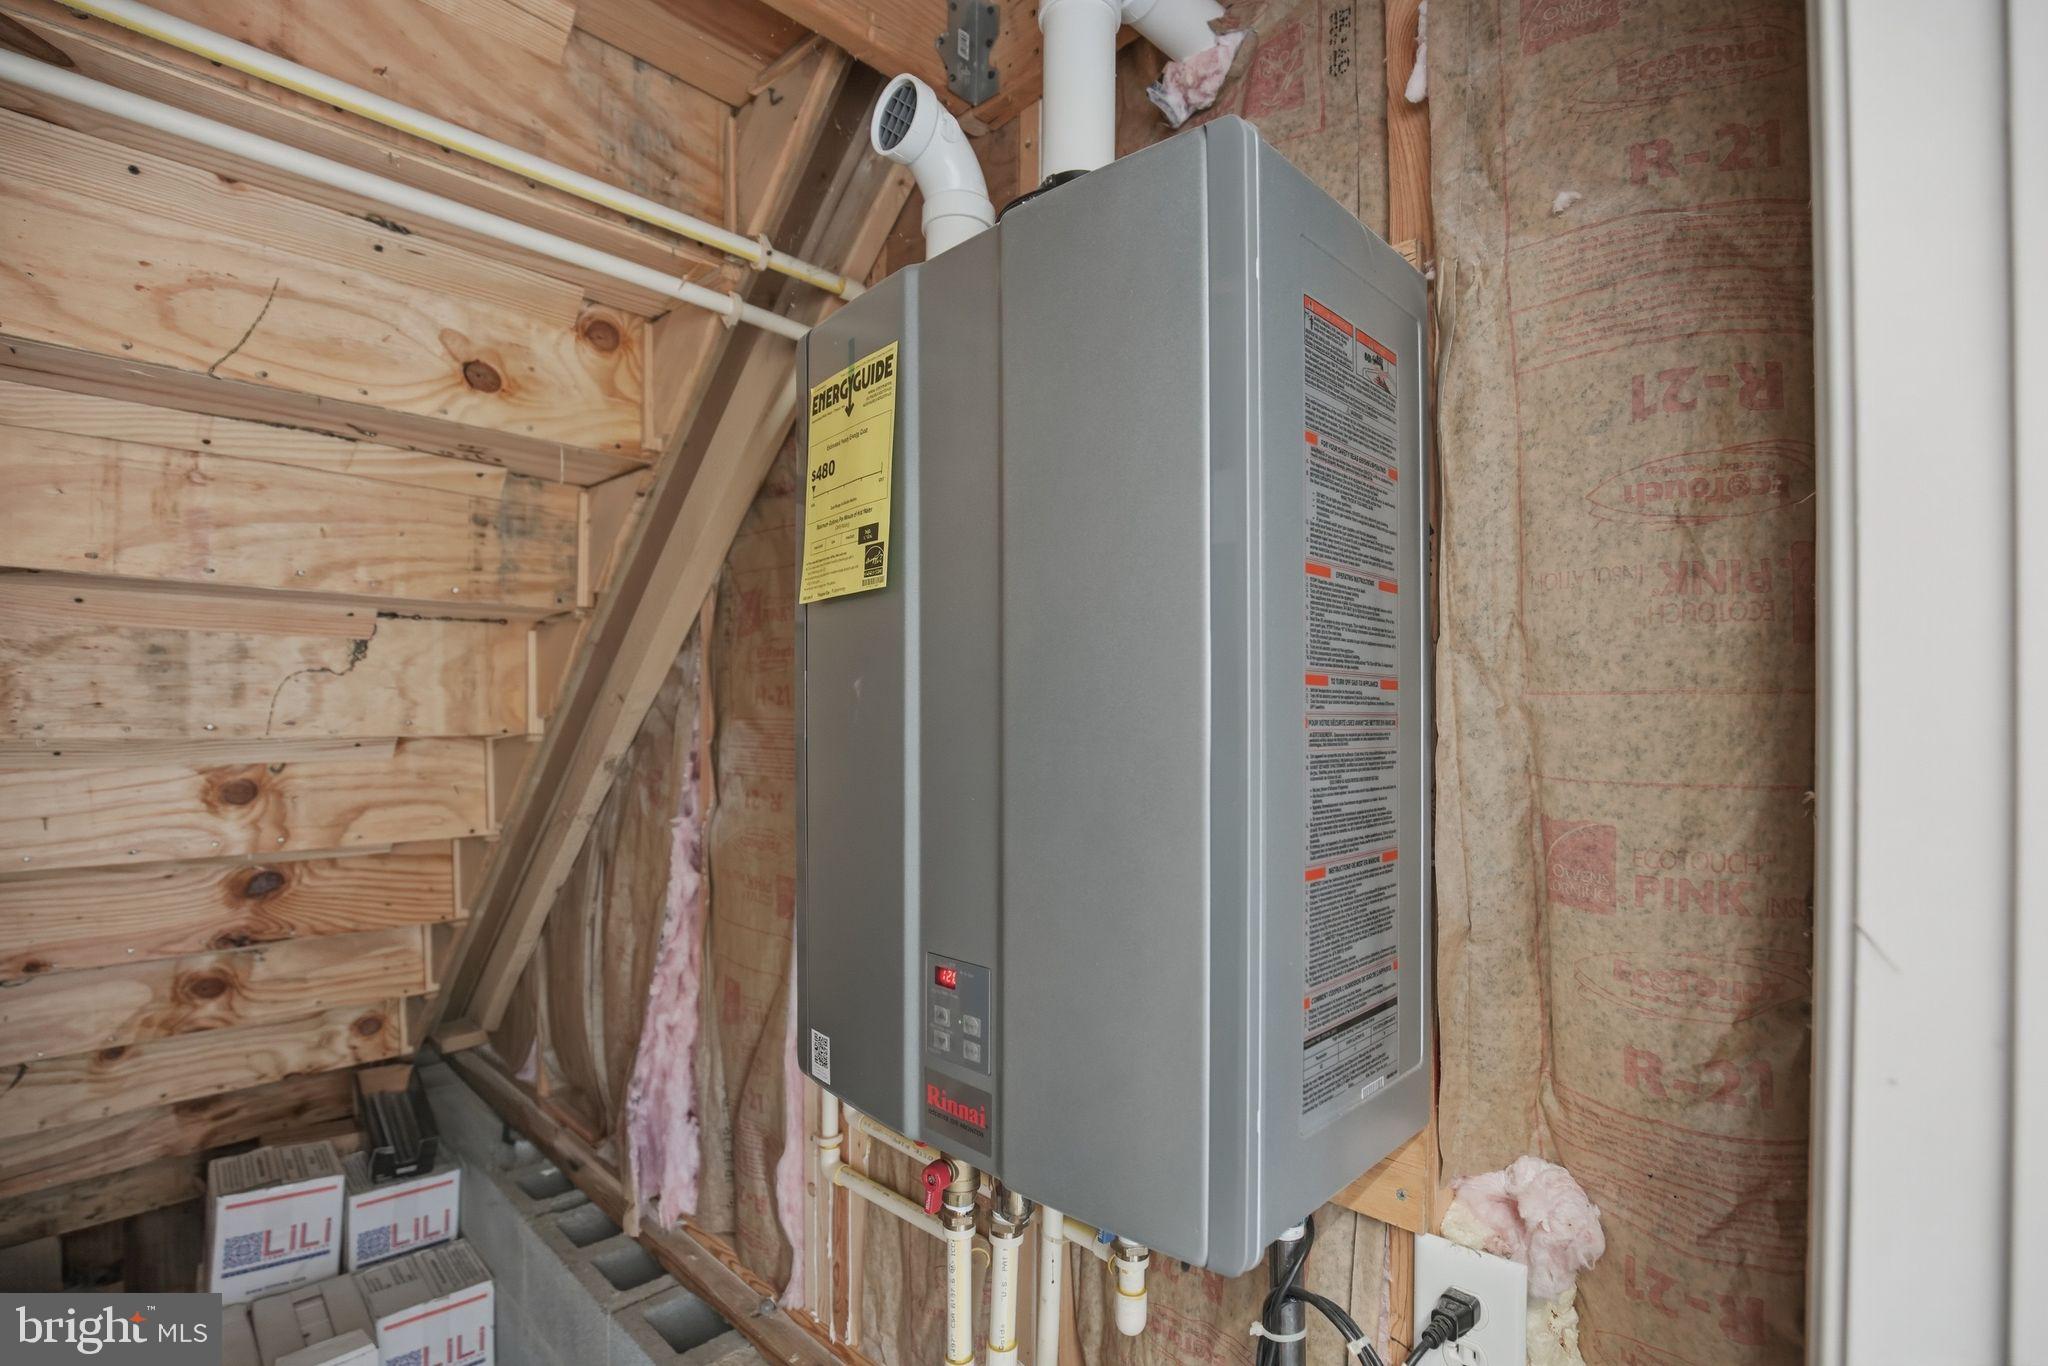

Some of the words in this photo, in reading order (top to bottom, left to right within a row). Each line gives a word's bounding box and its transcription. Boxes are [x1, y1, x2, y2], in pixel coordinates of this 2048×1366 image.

[1629, 119, 1783, 186] R-21
[1632, 361, 1784, 424] R-21
[811, 460, 835, 482] $480
[1634, 875, 1758, 918] PINK
[927, 1083, 986, 1130] Rinnai
[1624, 1043, 1776, 1110] R-21
[1624, 1254, 1769, 1346] R-21
